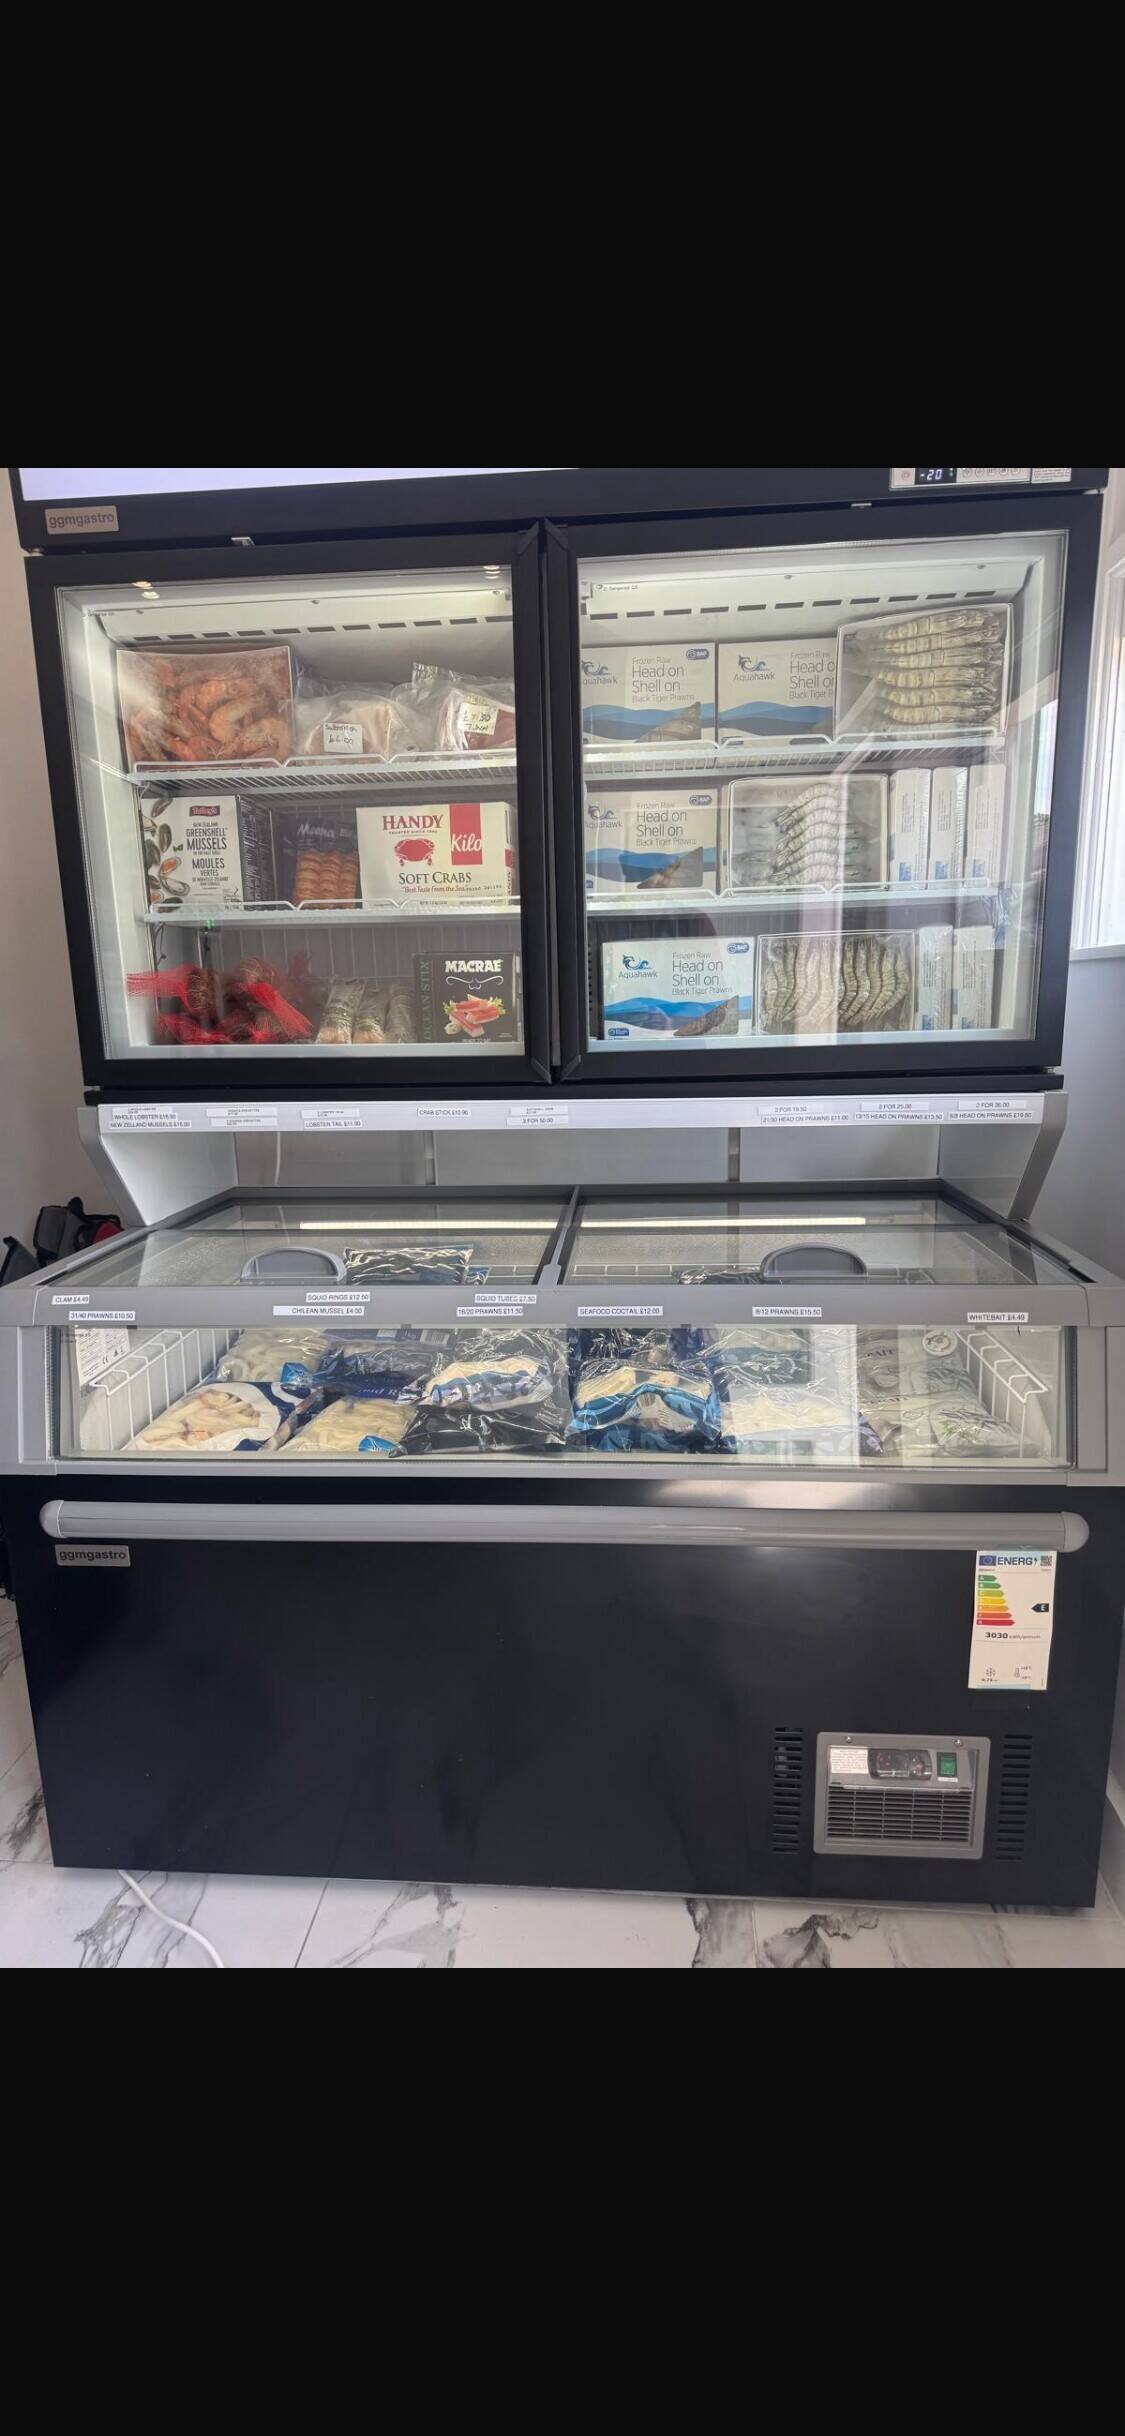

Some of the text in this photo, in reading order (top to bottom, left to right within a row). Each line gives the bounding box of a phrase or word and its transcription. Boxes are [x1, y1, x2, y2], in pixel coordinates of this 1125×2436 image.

[920, 469, 942, 480] -20
[49, 512, 115, 528] ggmgastro
[632, 664, 684, 678] Head on
[790, 659, 835, 674] Head o
[733, 673, 775, 681] Aquahawk
[790, 675, 820, 689] Shell
[632, 680, 680, 694] Shell on
[651, 694, 669, 703] Tiger
[382, 814, 444, 831] HANDY
[636, 809, 687, 823] Head on
[186, 828, 226, 836] GREENSHELL
[636, 824, 684, 837] Shell on
[186, 838, 228, 851] MUSSELS
[451, 832, 482, 852] Kilo
[636, 839, 654, 847] Black
[192, 858, 225, 869] MOULES
[400, 871, 472, 885] SOFT CRABS
[431, 885, 445, 893] From
[445, 884, 455, 892] the
[445, 960, 504, 973] MACRAE
[672, 959, 724, 973] Head on
[618, 971, 658, 979] Aquahawk
[672, 973, 719, 987] Shell on
[672, 987, 690, 995] Black
[708, 985, 733, 994] Prawns
[59, 1551, 127, 1561] ggmgastro
[997, 1557, 1033, 1566] ENERG
